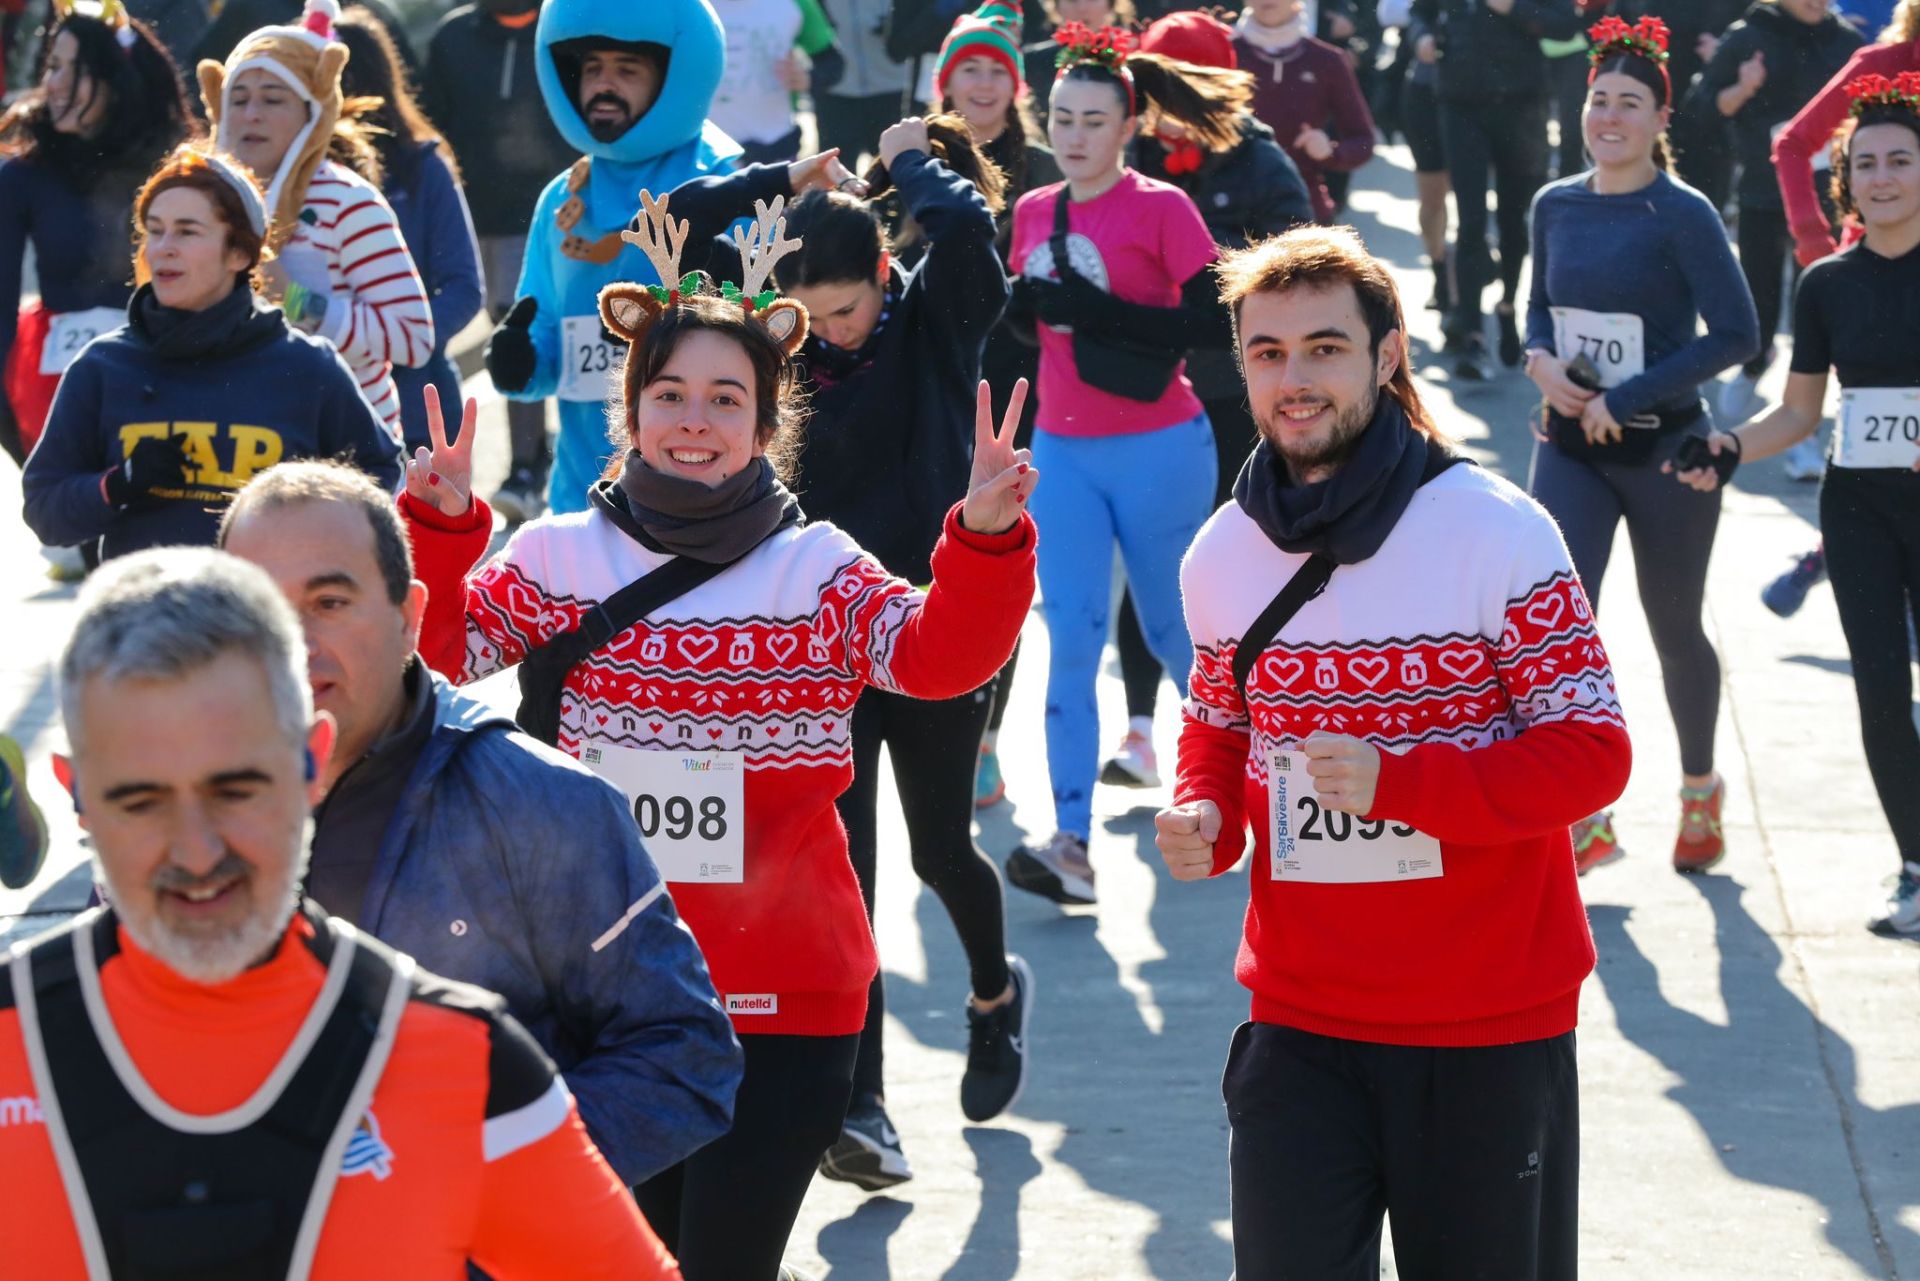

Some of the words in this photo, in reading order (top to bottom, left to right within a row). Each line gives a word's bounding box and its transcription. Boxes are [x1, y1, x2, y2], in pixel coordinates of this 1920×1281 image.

[1577, 334, 1623, 364] 770
[1864, 415, 1919, 441] 270
[682, 758, 711, 771] Vital
[730, 998, 771, 1009] nutella
